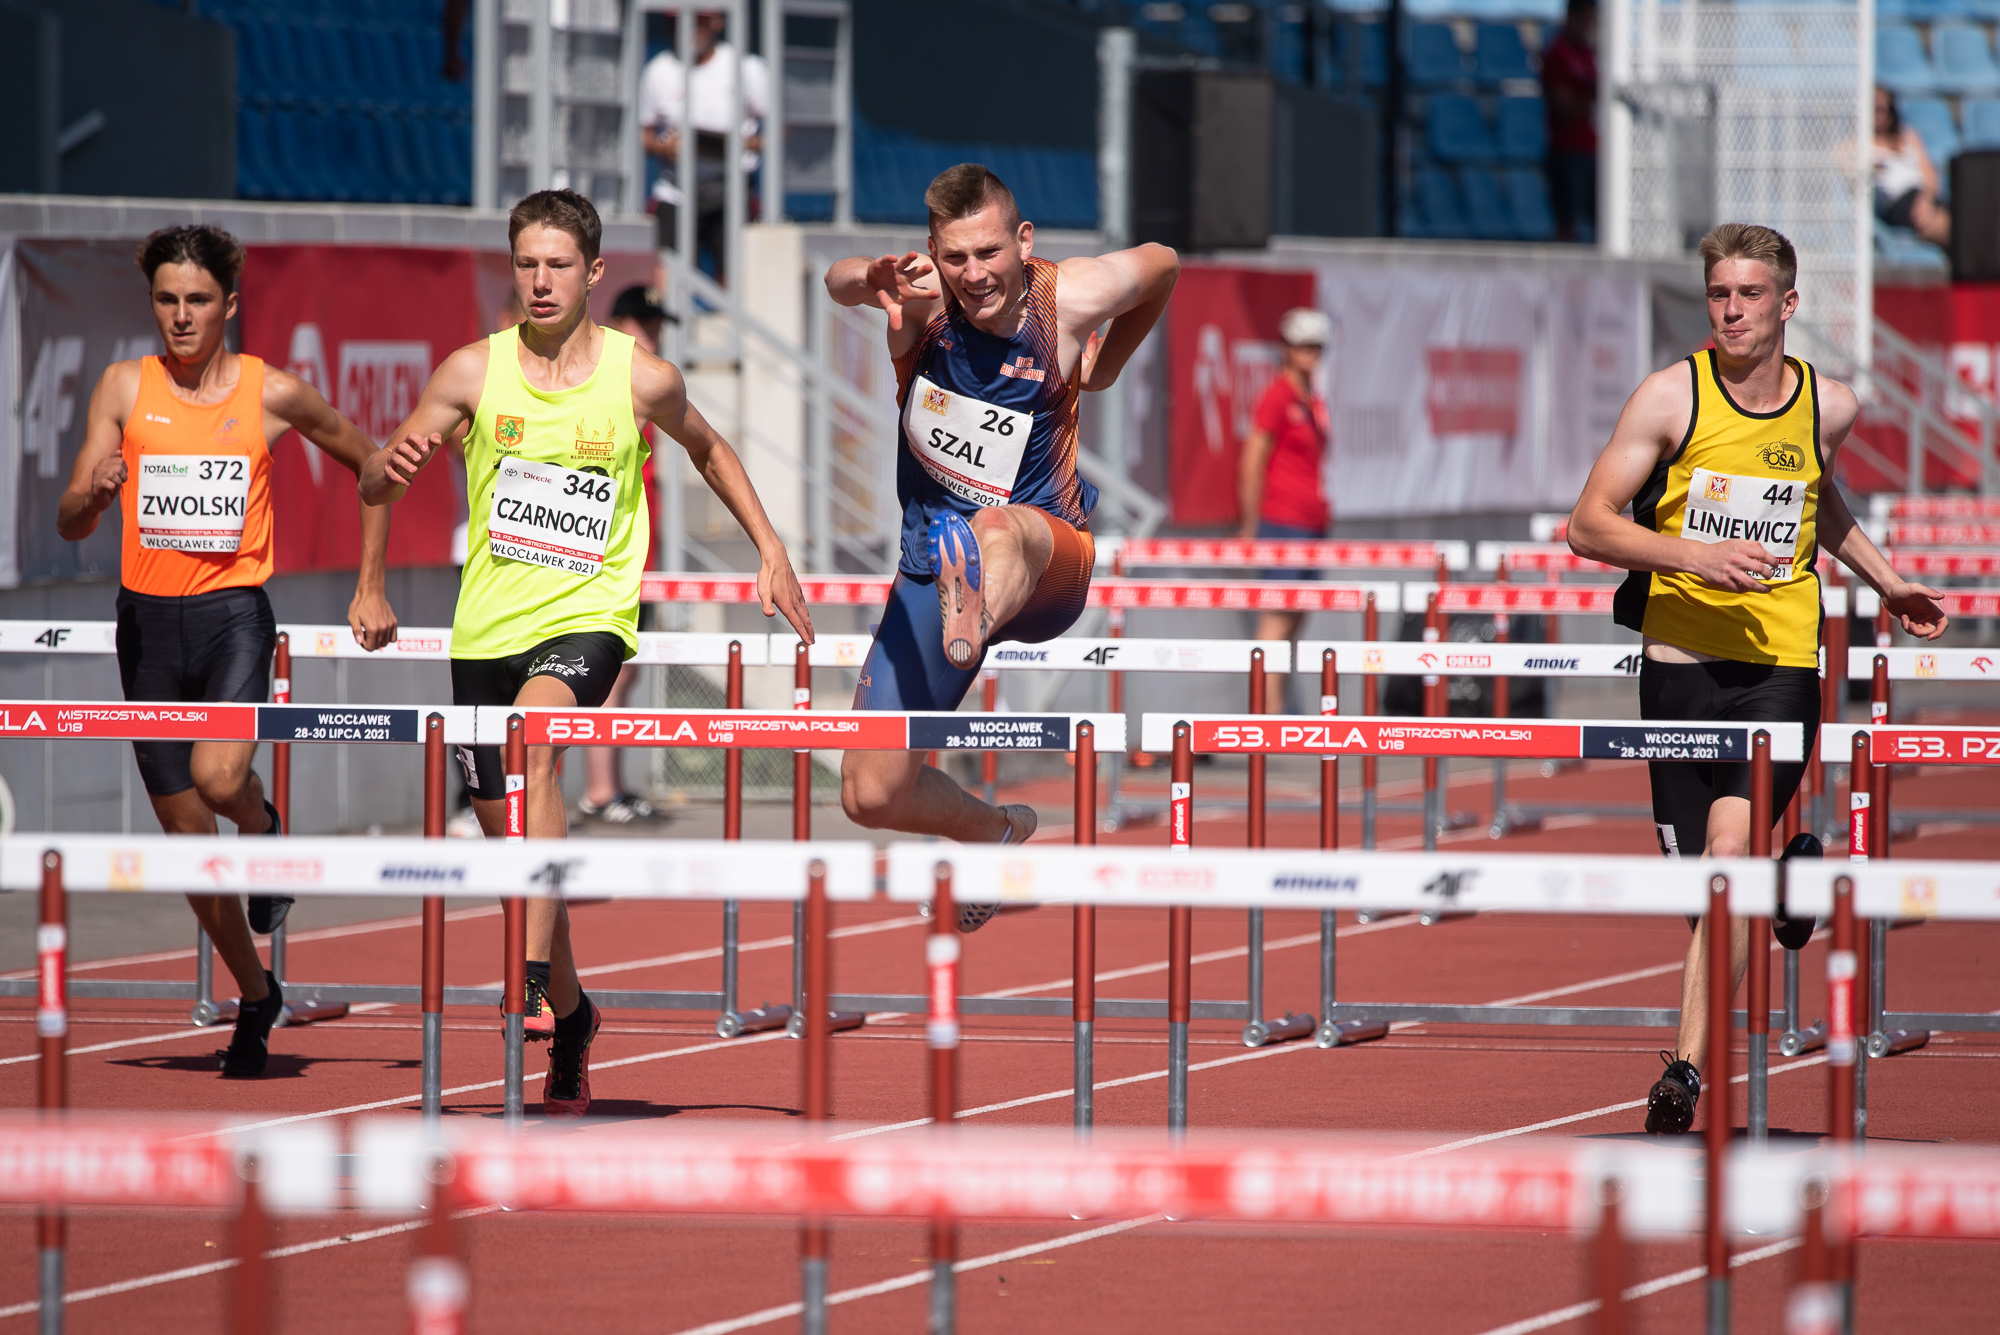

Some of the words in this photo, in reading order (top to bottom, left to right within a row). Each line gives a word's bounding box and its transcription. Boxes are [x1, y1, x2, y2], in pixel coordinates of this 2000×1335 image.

[979, 409, 1015, 436] 26
[576, 441, 613, 451] FENIKS
[928, 428, 986, 468] SZAL
[144, 464, 188, 474] TOTALbet
[1767, 452, 1796, 468] OSA
[199, 460, 243, 480] 372
[563, 474, 611, 502] 346
[1762, 484, 1794, 505] 44
[142, 495, 245, 517] ZWOLSKI
[973, 492, 1000, 507] 2021
[497, 497, 607, 541] CZARNOCKI
[1688, 508, 1797, 544] LINIEWICZ
[146, 537, 215, 549] WŁOCŁAWEK
[503, 535, 519, 543] PZLA
[519, 538, 563, 553] MISTRZOSTWA
[564, 548, 586, 558] POLSKI
[491, 541, 565, 568] WŁOCŁAWEK
[568, 560, 595, 574] 2021
[34, 628, 71, 647] 4F
[1083, 646, 1120, 666] 4F
[1447, 655, 1491, 668] ORLEN
[1524, 657, 1580, 670] 4MOVE
[0, 709, 47, 731] LA
[57, 709, 158, 722] MISTRZOSTWA
[159, 711, 208, 722] POLSKI
[318, 713, 391, 726] WŁOCŁAWEK
[57, 721, 83, 733] U18
[294, 727, 325, 739] 28-30
[329, 727, 361, 740] LIPCA
[364, 728, 390, 740] 2021
[548, 718, 602, 740] 53.
[612, 719, 698, 742] PZLA
[708, 720, 808, 732] MISTRZOSTWA
[810, 721, 859, 733] POLSKI
[969, 721, 1043, 733] WŁOCŁAWEK
[1378, 727, 1481, 740] MISTRZOSTWA
[1482, 730, 1532, 741] POLSKI
[708, 732, 734, 743] U18
[946, 735, 978, 747] 28-30
[981, 736, 1013, 747] LIPCA
[1016, 736, 1042, 748] 2021
[1217, 726, 1271, 748] 53.
[1281, 727, 1368, 749] PZLA
[1378, 740, 1405, 751] U18
[1644, 732, 1720, 745] WŁOCŁAWEK
[1897, 736, 1952, 758] 53.
[1620, 746, 1653, 758] 28-30
[1656, 747, 1690, 759] LIPCA
[1692, 747, 1719, 759] 2021
[509, 795, 520, 834] polanik
[1174, 803, 1186, 842] polanik
[1853, 812, 1865, 852] polanik
